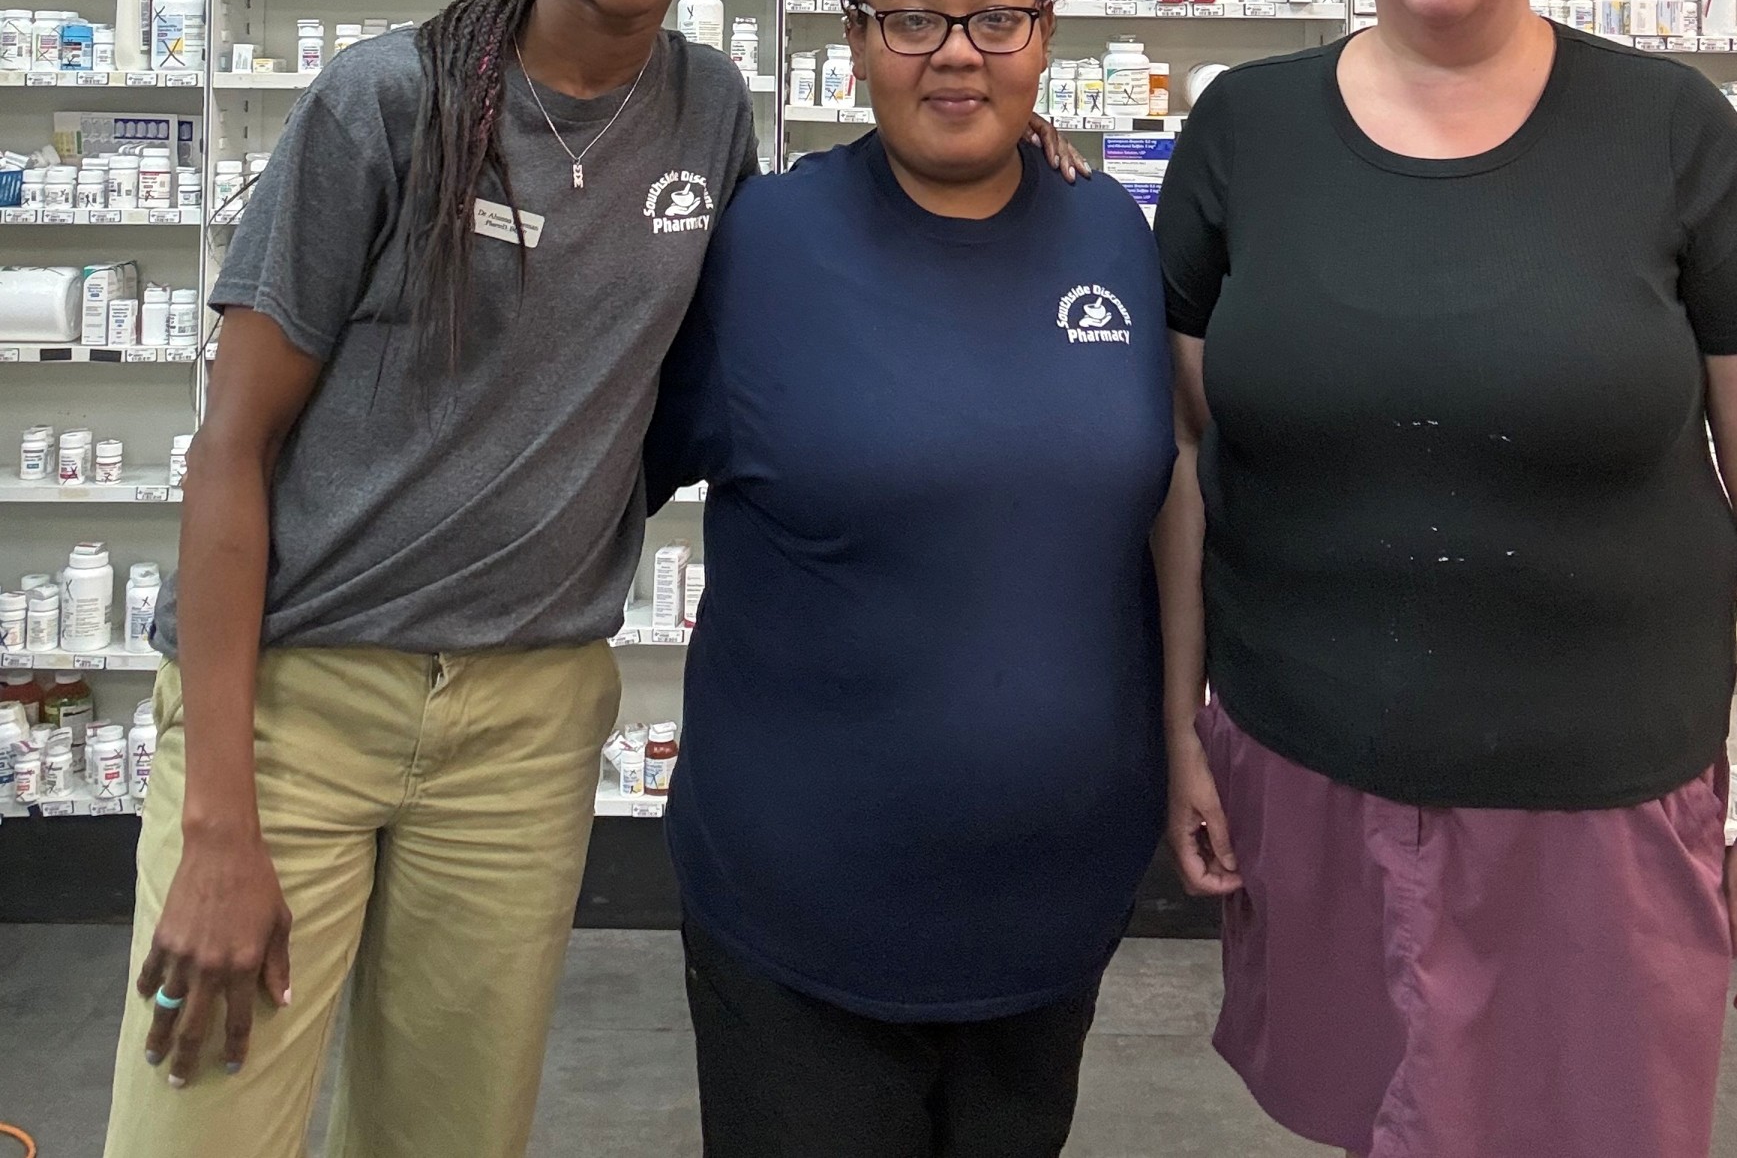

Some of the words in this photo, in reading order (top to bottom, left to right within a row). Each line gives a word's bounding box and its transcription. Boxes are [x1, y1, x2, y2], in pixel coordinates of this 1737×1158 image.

[643, 170, 679, 217] Southside
[1056, 285, 1091, 329] Southside
[1092, 284, 1132, 326] Discount
[1067, 328, 1130, 345] Pharmacy
